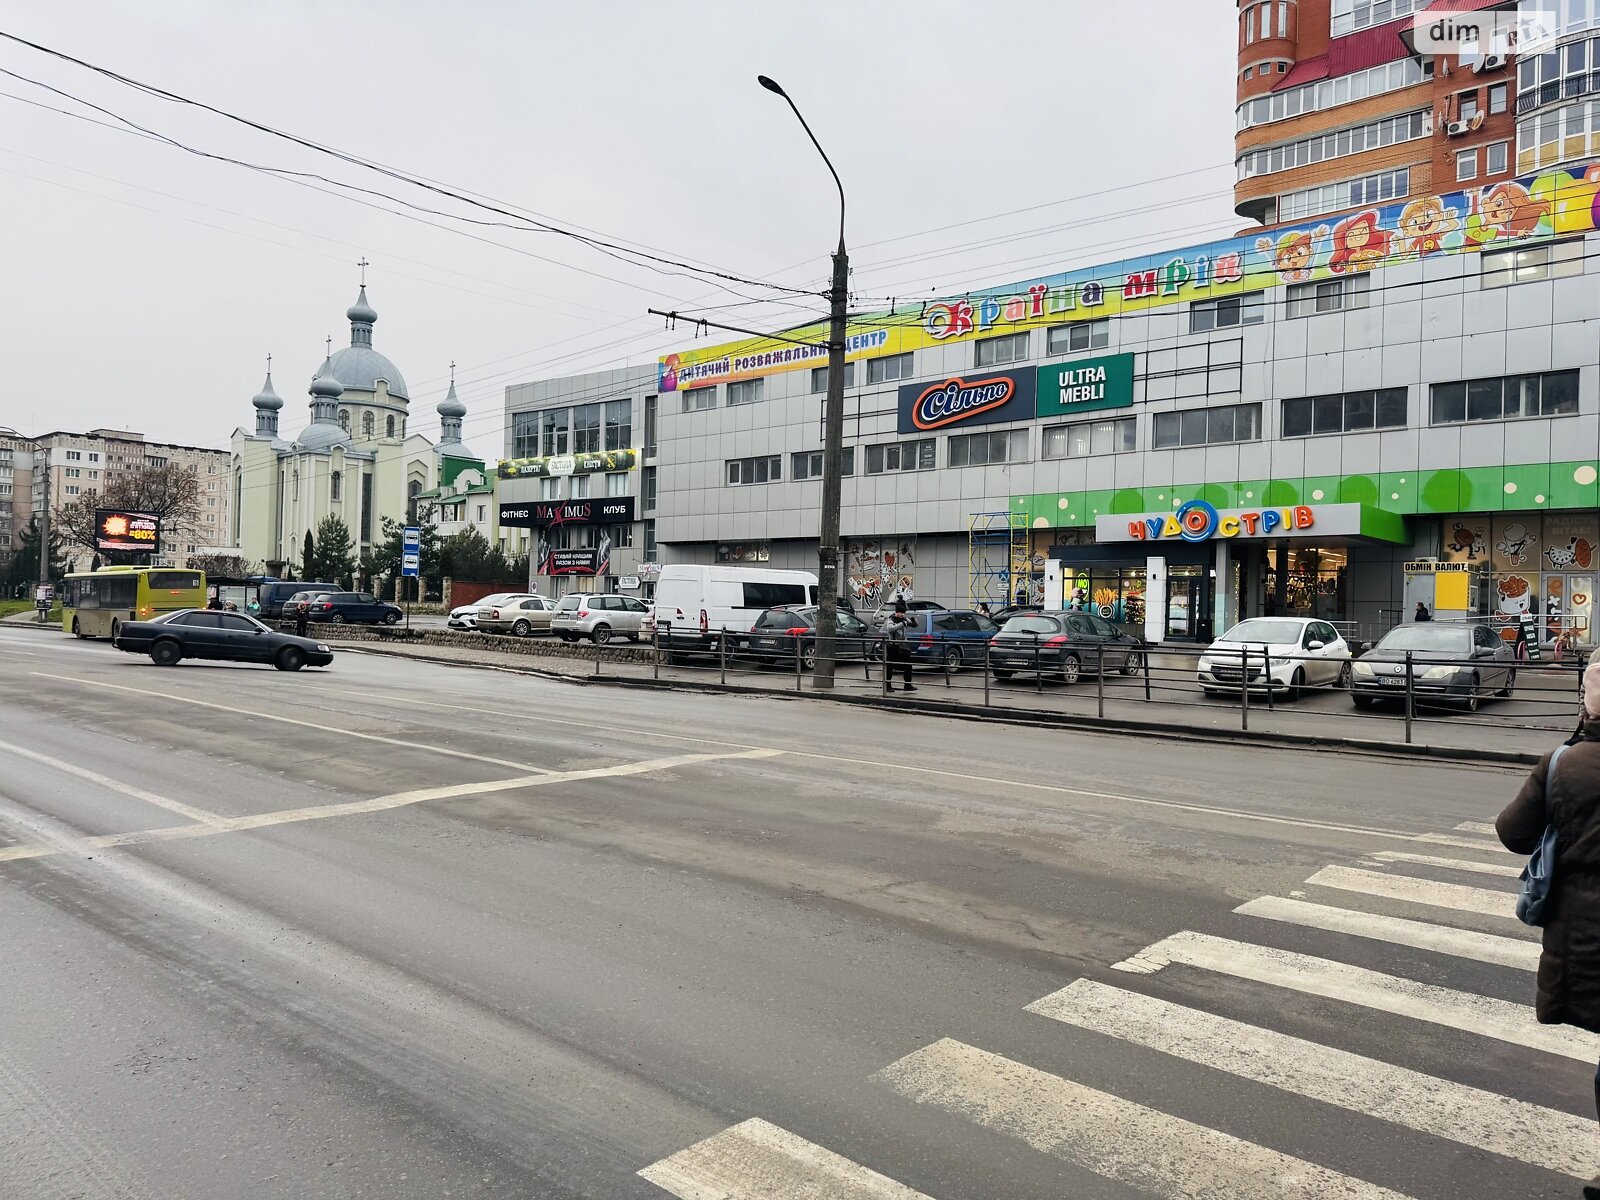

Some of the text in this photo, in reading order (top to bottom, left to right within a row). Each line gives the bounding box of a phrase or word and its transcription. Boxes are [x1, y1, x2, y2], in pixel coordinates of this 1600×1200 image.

[924, 250, 1243, 341] Країна мрій
[679, 357, 731, 382] ДИТЯЧИЙ
[734, 342, 829, 371] РОЗВАЖАЛЬНИ
[1059, 365, 1107, 387] ULTRA
[920, 381, 1009, 421] Сільпо
[1059, 383, 1105, 404] MEBLI
[501, 509, 529, 519] ФІТНЕС
[603, 505, 627, 514] КЛУБ
[1405, 562, 1465, 572] ОБМІН ВАЛЮТ
